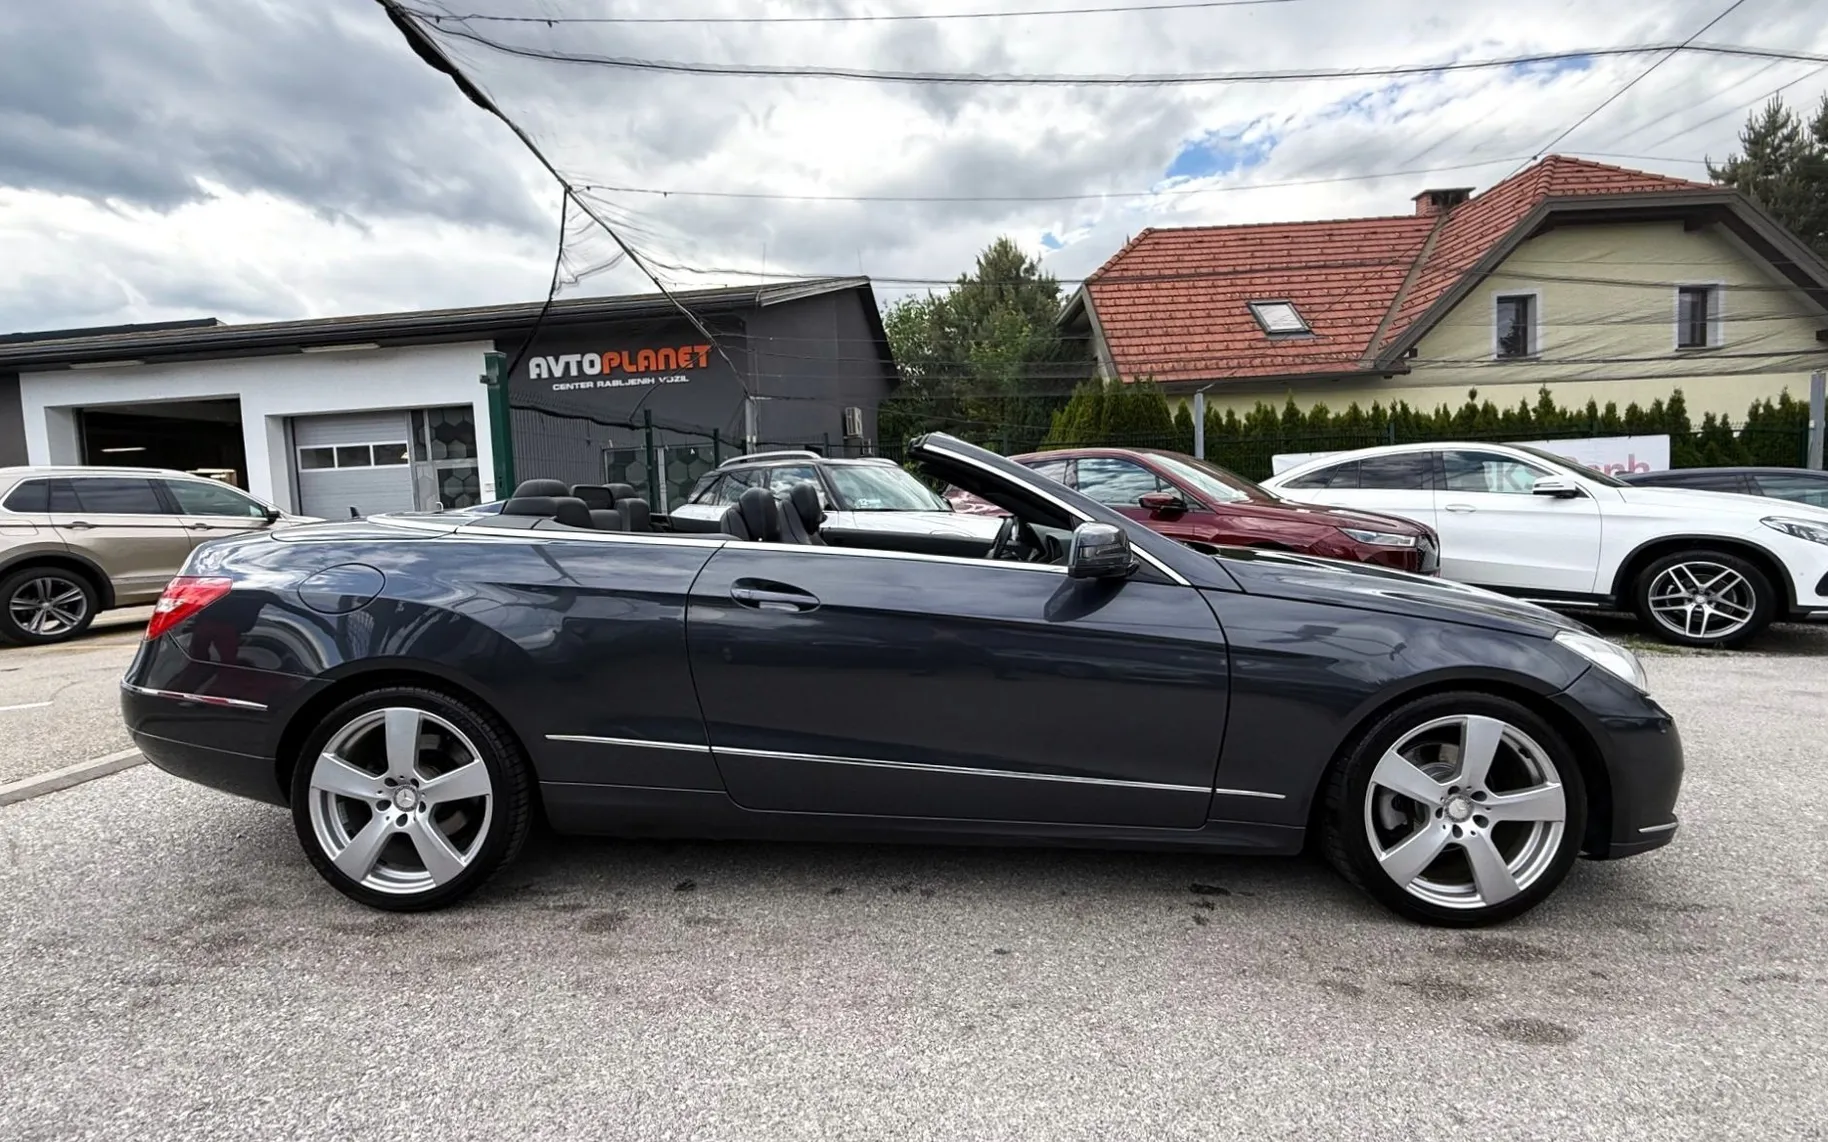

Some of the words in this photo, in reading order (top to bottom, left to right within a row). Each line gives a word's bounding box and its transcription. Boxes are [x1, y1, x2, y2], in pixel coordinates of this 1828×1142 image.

[529, 345, 711, 379] AVTOPLANET
[552, 380, 594, 391] CENTER
[597, 377, 655, 388] RABLJENIH
